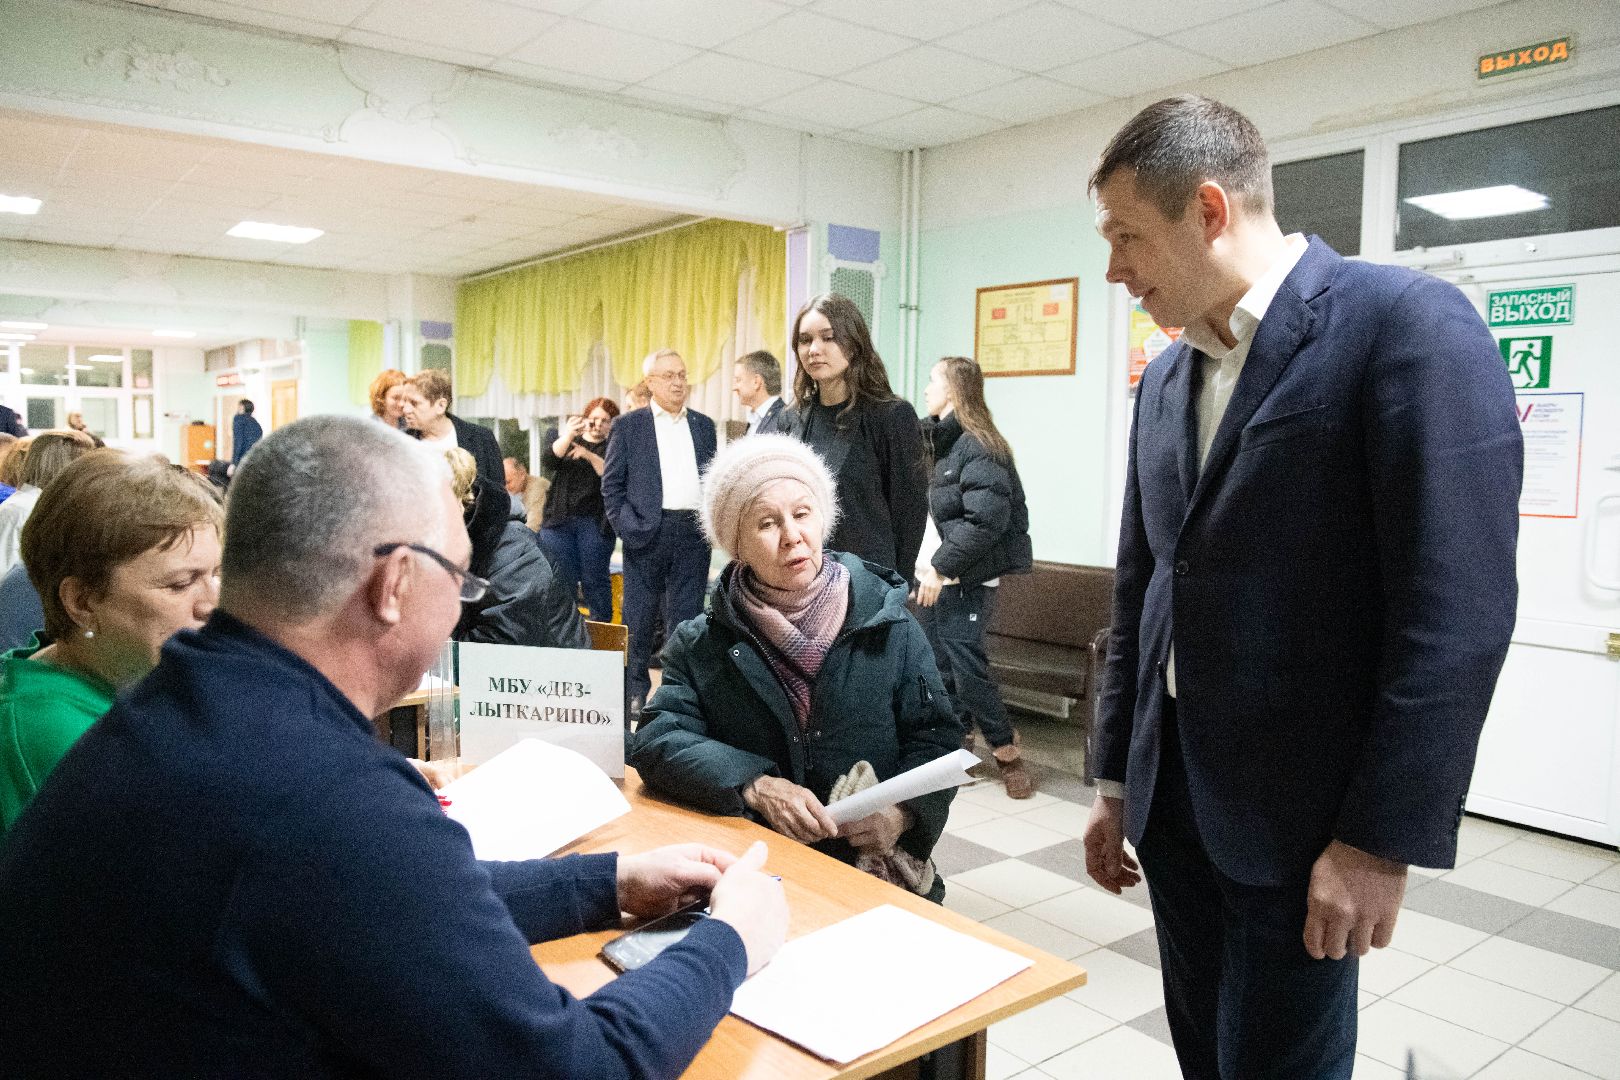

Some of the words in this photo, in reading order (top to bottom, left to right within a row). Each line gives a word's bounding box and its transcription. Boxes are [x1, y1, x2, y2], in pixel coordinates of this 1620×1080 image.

[1480, 41, 1569, 73] ВЫХОД
[1491, 288, 1572, 307] ЗАПАСНЫЙ
[1490, 302, 1570, 322] ВЫХОД
[488, 676, 532, 694] МБУ
[537, 680, 591, 699] «ДЕЗ-
[469, 701, 611, 726] ЛЫТКАРИНО»
